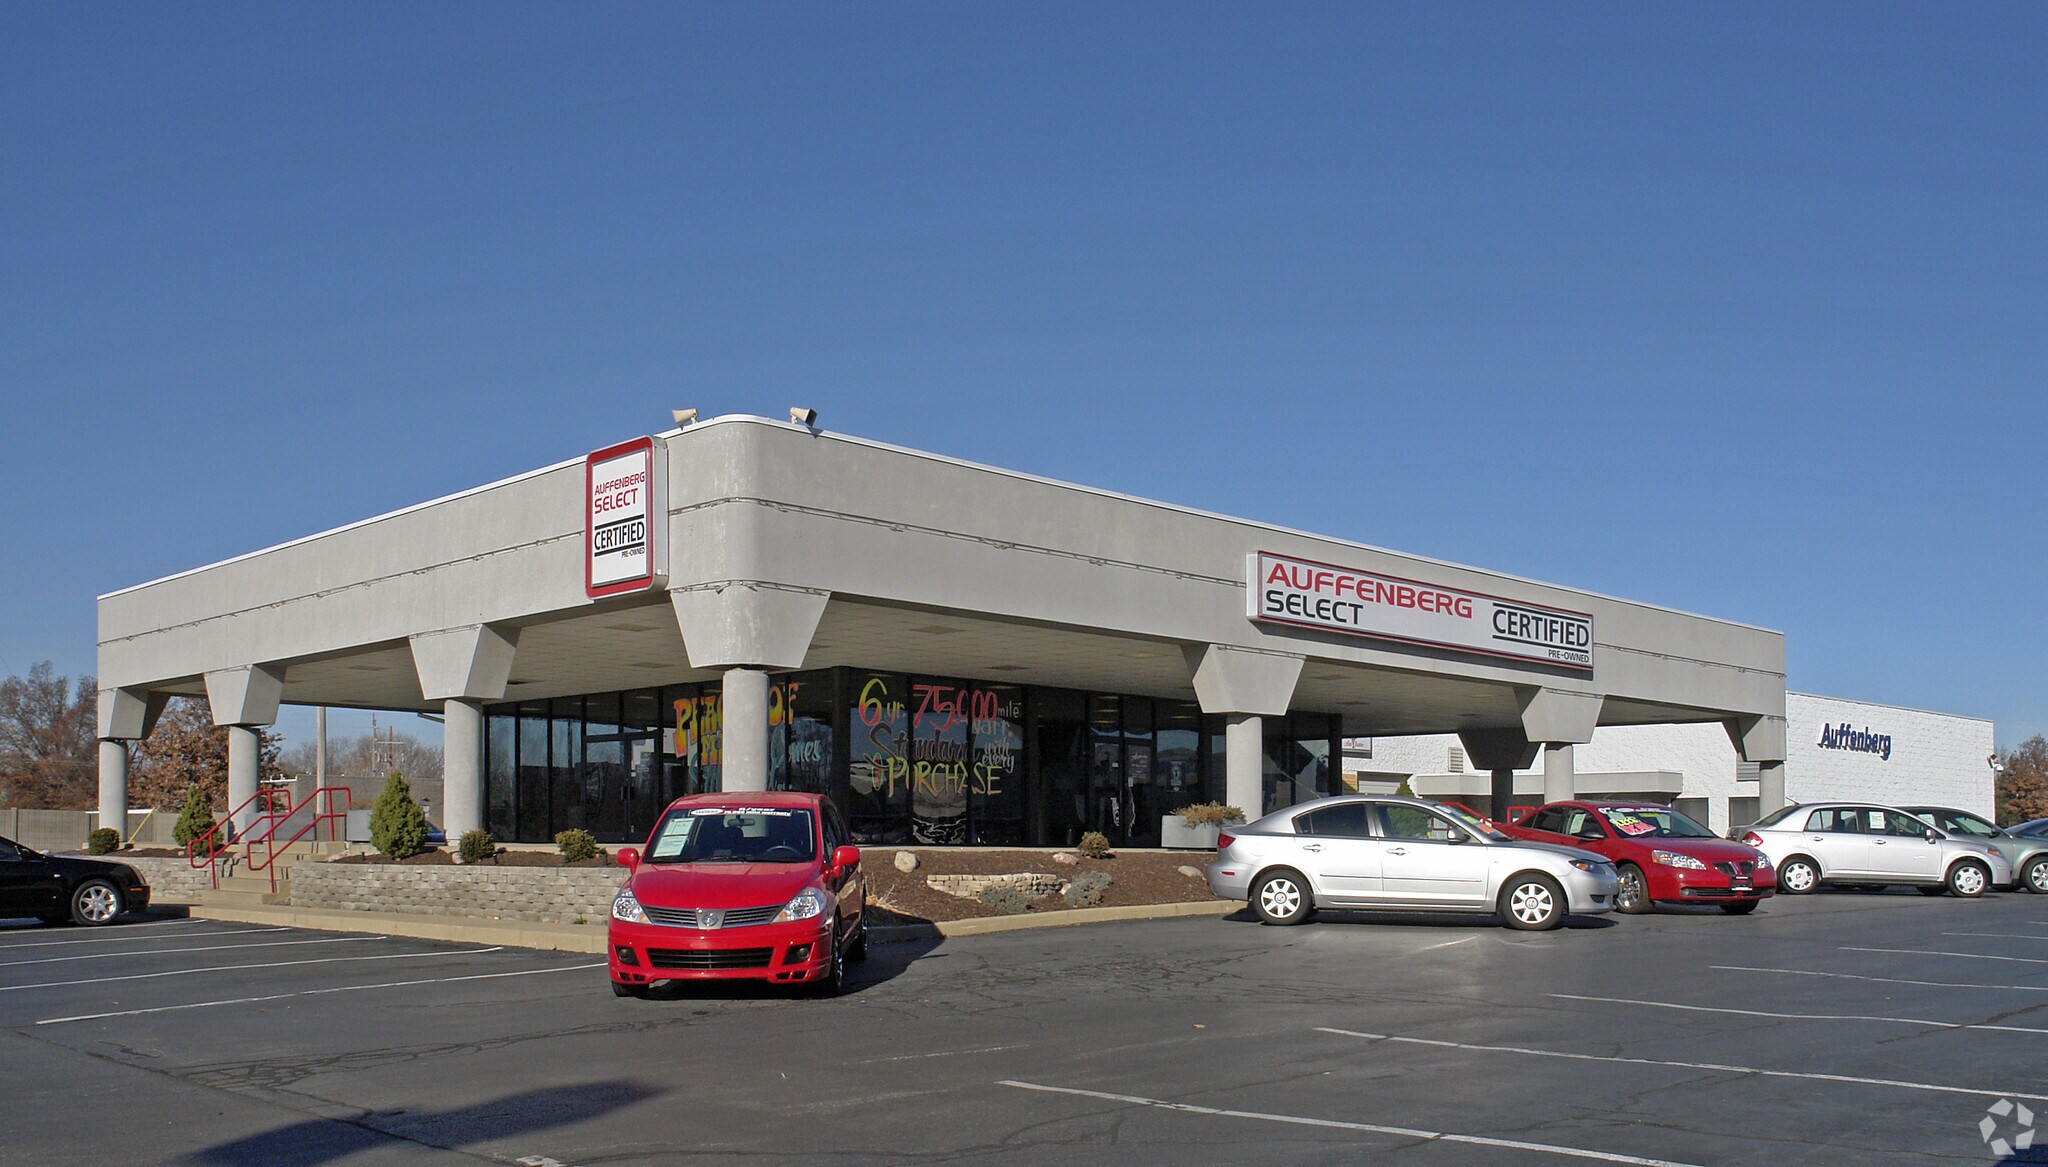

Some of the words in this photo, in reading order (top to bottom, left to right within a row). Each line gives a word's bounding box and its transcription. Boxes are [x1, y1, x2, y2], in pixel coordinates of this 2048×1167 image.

[594, 471, 645, 496] AUFFENBERG
[594, 487, 638, 514] SELECT
[594, 521, 645, 551] CERTIFIED
[621, 547, 645, 559] PRE-OWNED
[1266, 562, 1474, 619] AUFFENBERG
[1265, 590, 1364, 625] SELECT
[1492, 608, 1590, 647] CERTIFIED
[1548, 649, 1590, 664] PRE-OWNED
[858, 678, 888, 727] 6
[998, 701, 1020, 719] mile
[1819, 723, 1891, 760] Auffenberg
